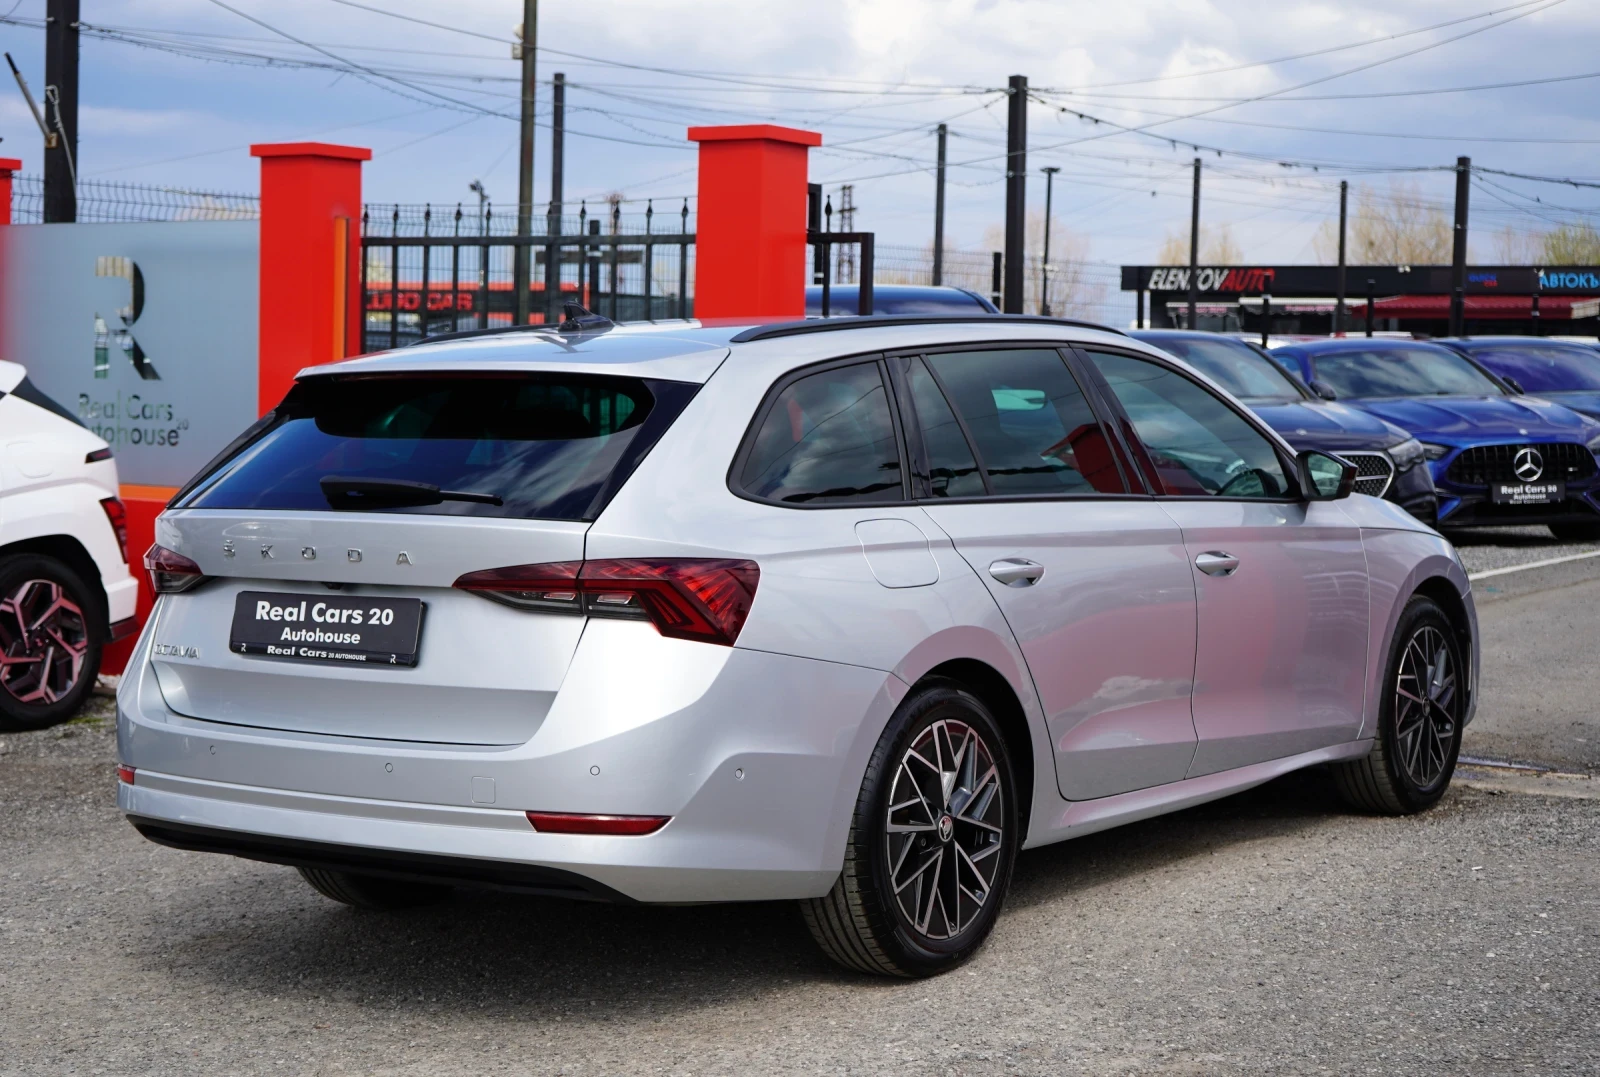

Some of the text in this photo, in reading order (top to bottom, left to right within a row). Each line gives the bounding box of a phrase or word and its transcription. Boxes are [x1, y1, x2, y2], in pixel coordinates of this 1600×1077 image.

[78, 392, 173, 421] Real Cars
[1501, 485, 1523, 494] Real
[1525, 485, 1546, 493] Cars
[255, 600, 394, 626] Real Cars 20
[280, 626, 361, 645] Autohouse
[266, 645, 367, 662] Real Cars 20 AUTOHOUSE
